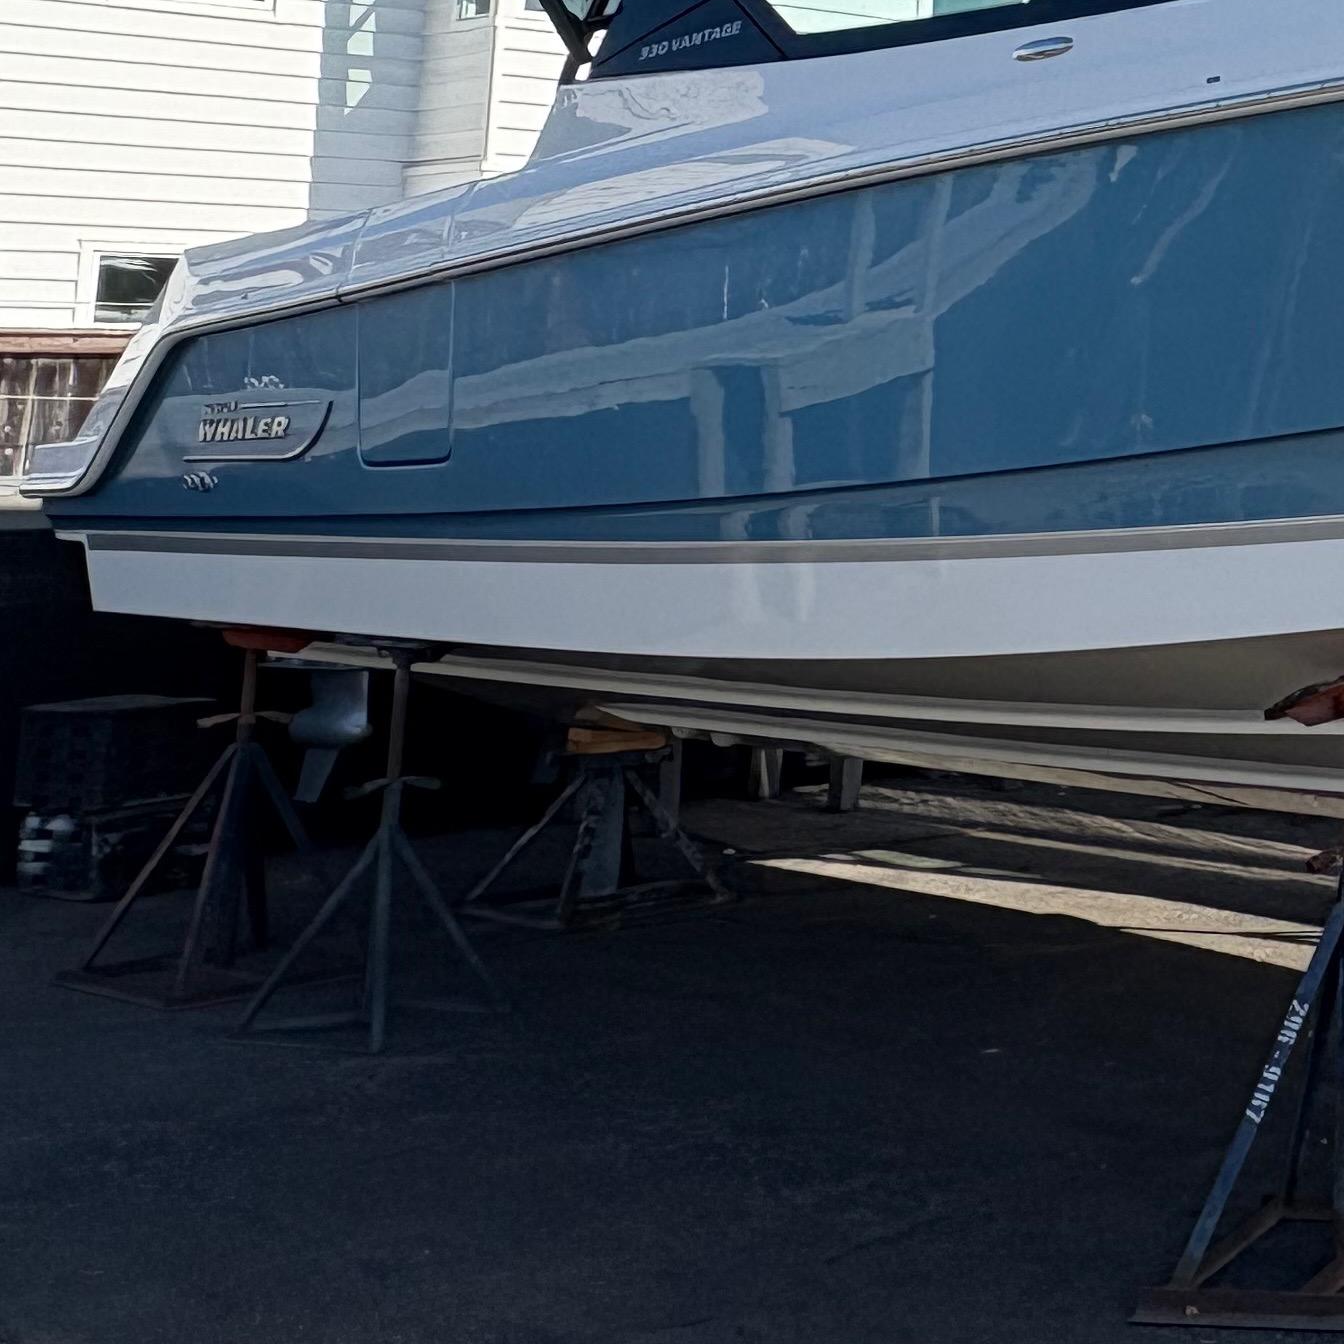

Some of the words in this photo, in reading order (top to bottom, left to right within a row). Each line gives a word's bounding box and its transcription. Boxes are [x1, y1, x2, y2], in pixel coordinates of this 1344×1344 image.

[639, 41, 669, 61] 330
[671, 20, 742, 52] VANTAGE
[198, 415, 289, 443] WHALER
